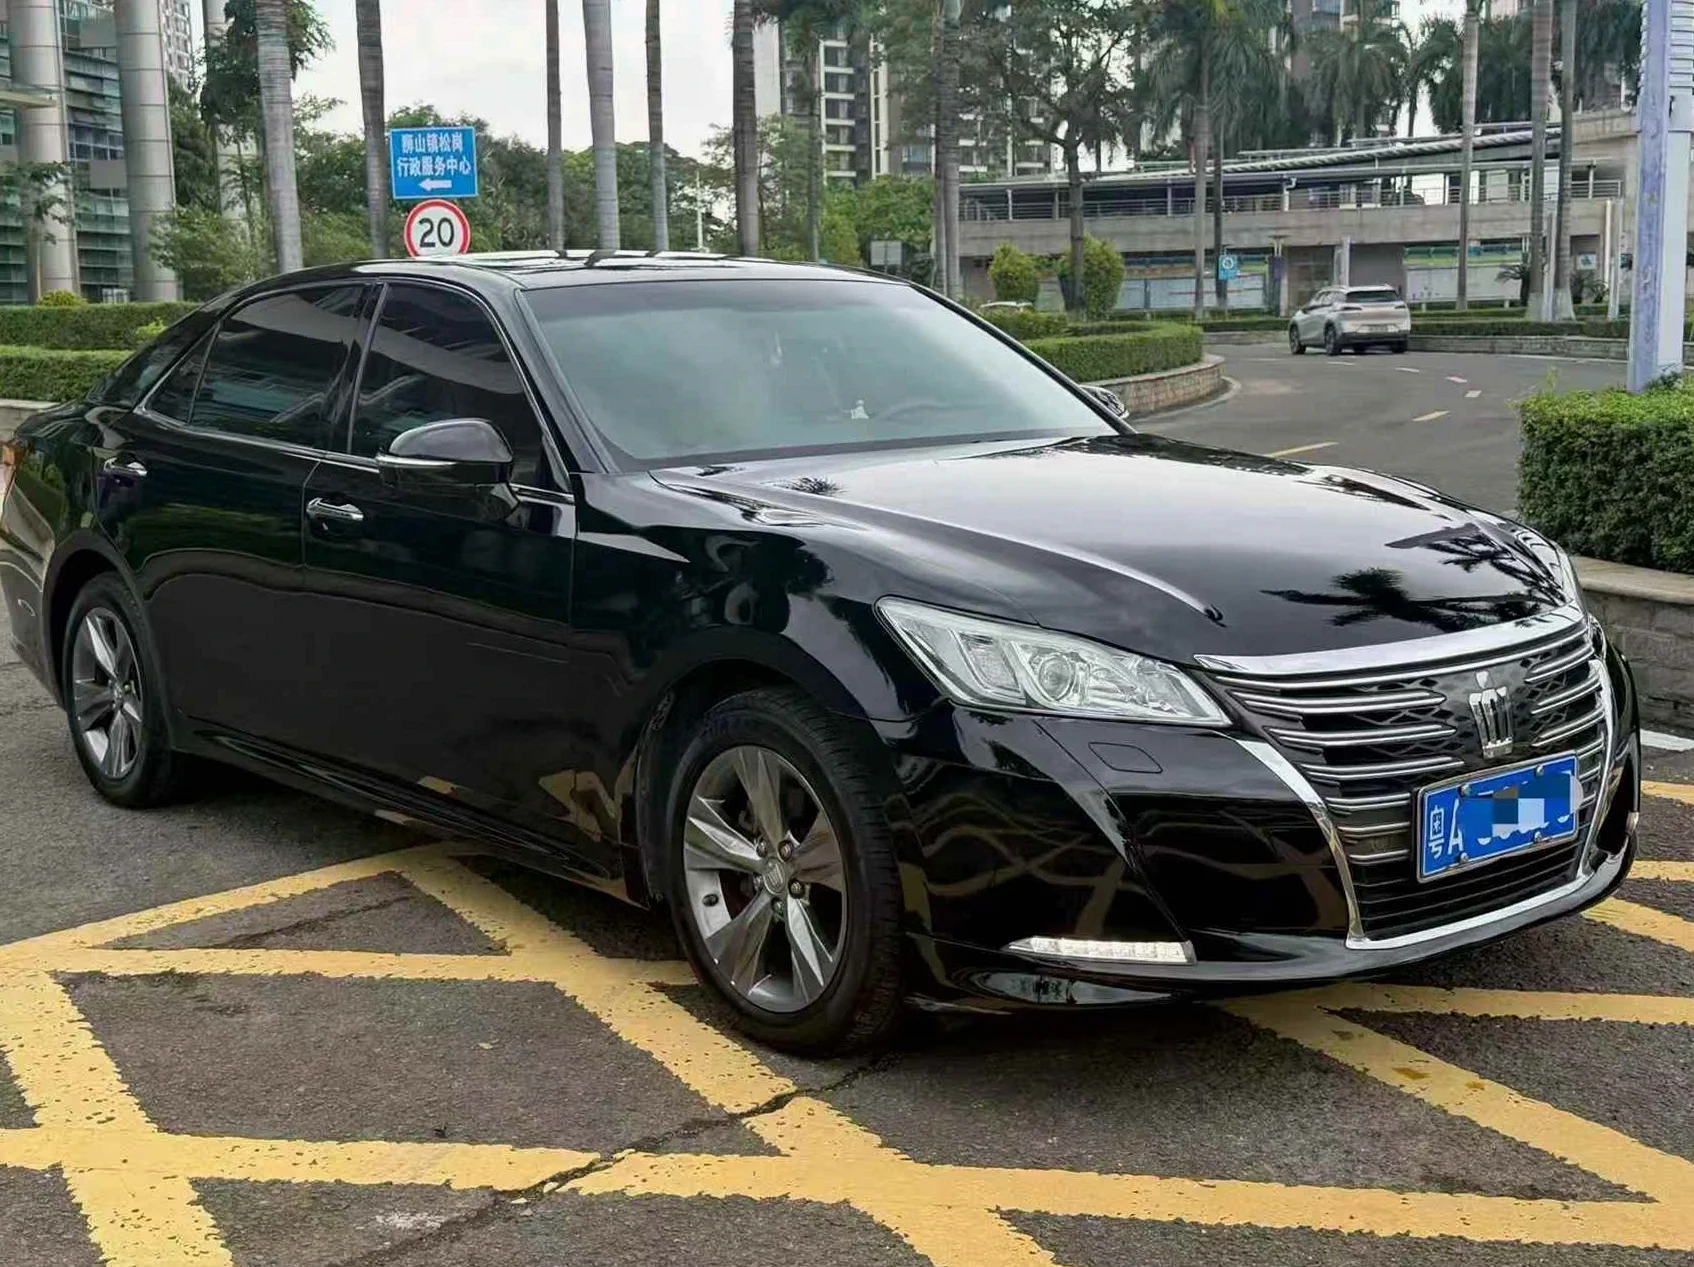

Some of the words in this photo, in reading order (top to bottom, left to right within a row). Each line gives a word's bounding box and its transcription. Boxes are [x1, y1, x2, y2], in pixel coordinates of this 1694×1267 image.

[397, 156, 471, 177] 行政服务中心
[418, 217, 455, 248] 20
